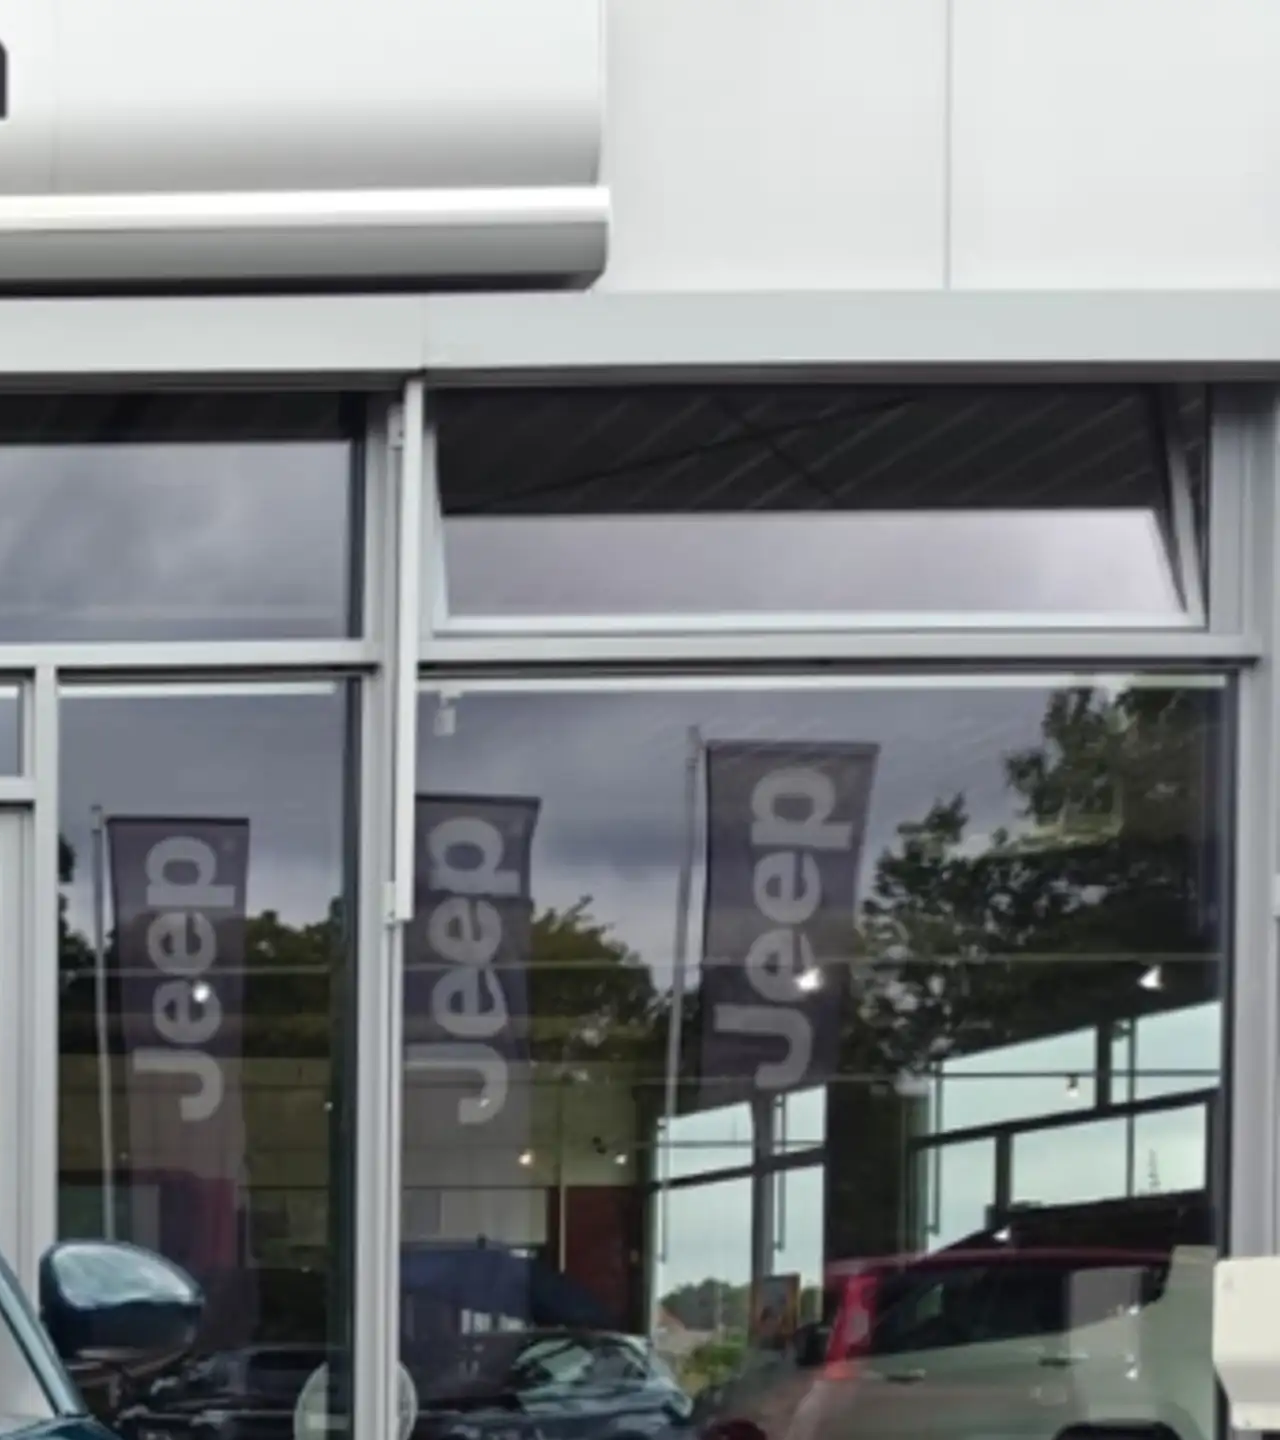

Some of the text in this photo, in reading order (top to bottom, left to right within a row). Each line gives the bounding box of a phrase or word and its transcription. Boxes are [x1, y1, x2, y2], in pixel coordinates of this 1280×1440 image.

[132, 836, 235, 1122] Jeep
[404, 818, 523, 1125] Jeep
[711, 766, 852, 1089] Jeep
